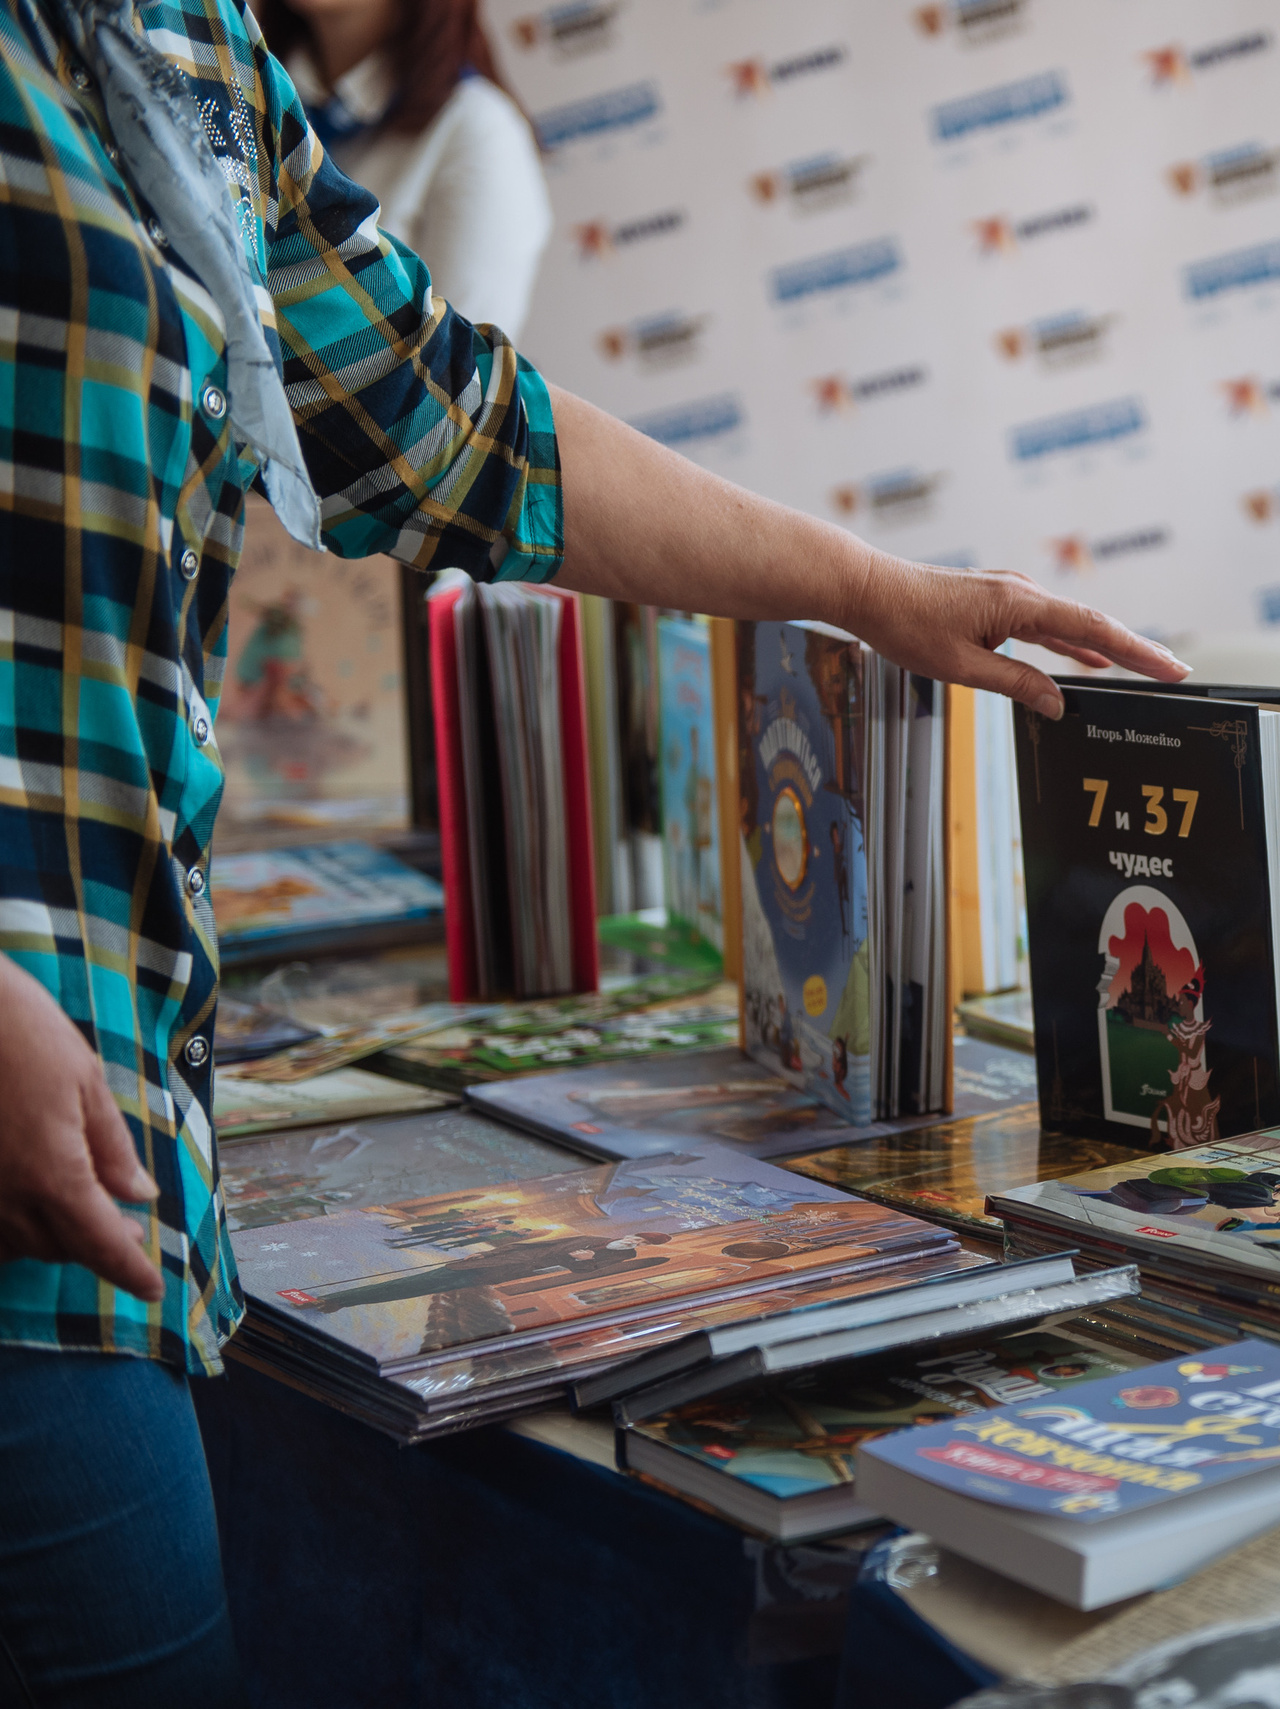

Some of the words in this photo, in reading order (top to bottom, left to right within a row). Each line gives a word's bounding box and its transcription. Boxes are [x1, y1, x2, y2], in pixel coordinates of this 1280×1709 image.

[1086, 724, 1123, 742] Игорь
[1124, 728, 1182, 748] Можейко
[1082, 777, 1109, 828] 7
[1115, 810, 1130, 831] и
[1141, 784, 1200, 838] 37
[1108, 850, 1174, 879] чудес
